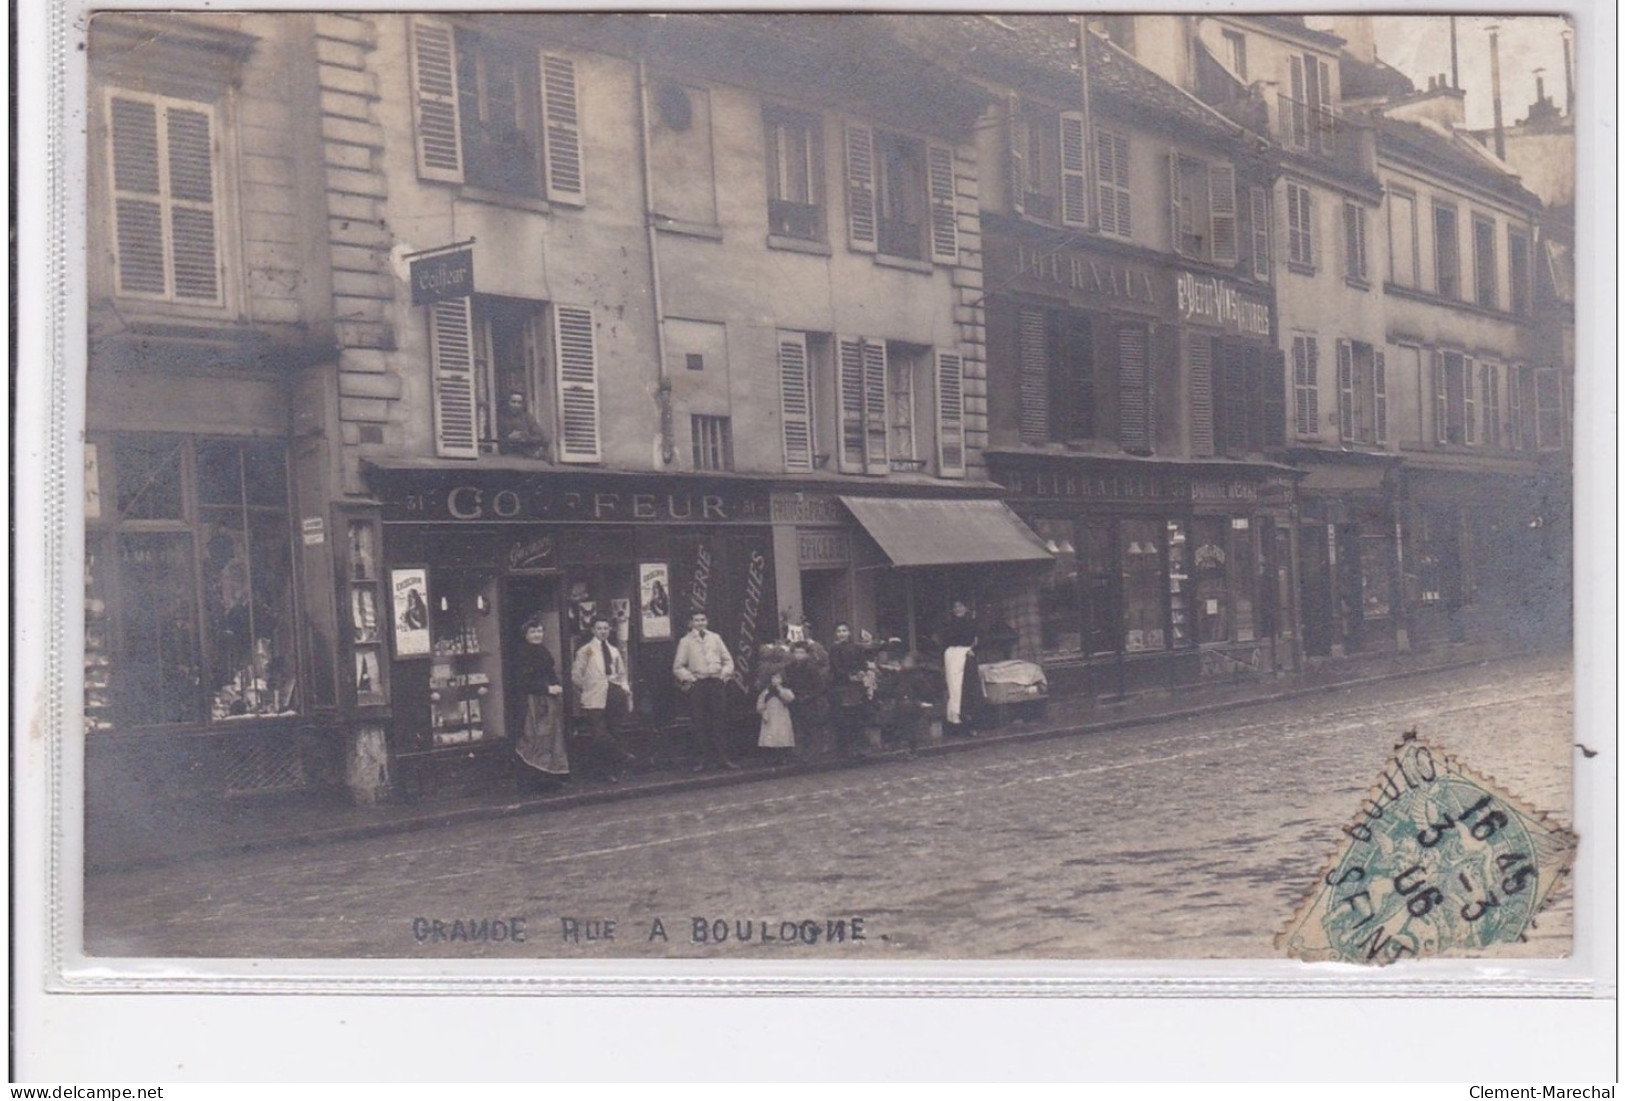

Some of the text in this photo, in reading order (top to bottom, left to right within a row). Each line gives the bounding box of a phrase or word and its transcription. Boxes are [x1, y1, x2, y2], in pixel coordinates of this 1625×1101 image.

[1015, 241, 1155, 304] JOURNAUX
[446, 486, 728, 519] COFFEUR
[1036, 474, 1161, 497] LIBRAIRIE
[733, 549, 765, 695] POSTICHES
[1416, 812, 1457, 848] 3
[1460, 890, 1501, 922] 3
[1458, 795, 1539, 894] 16 45
